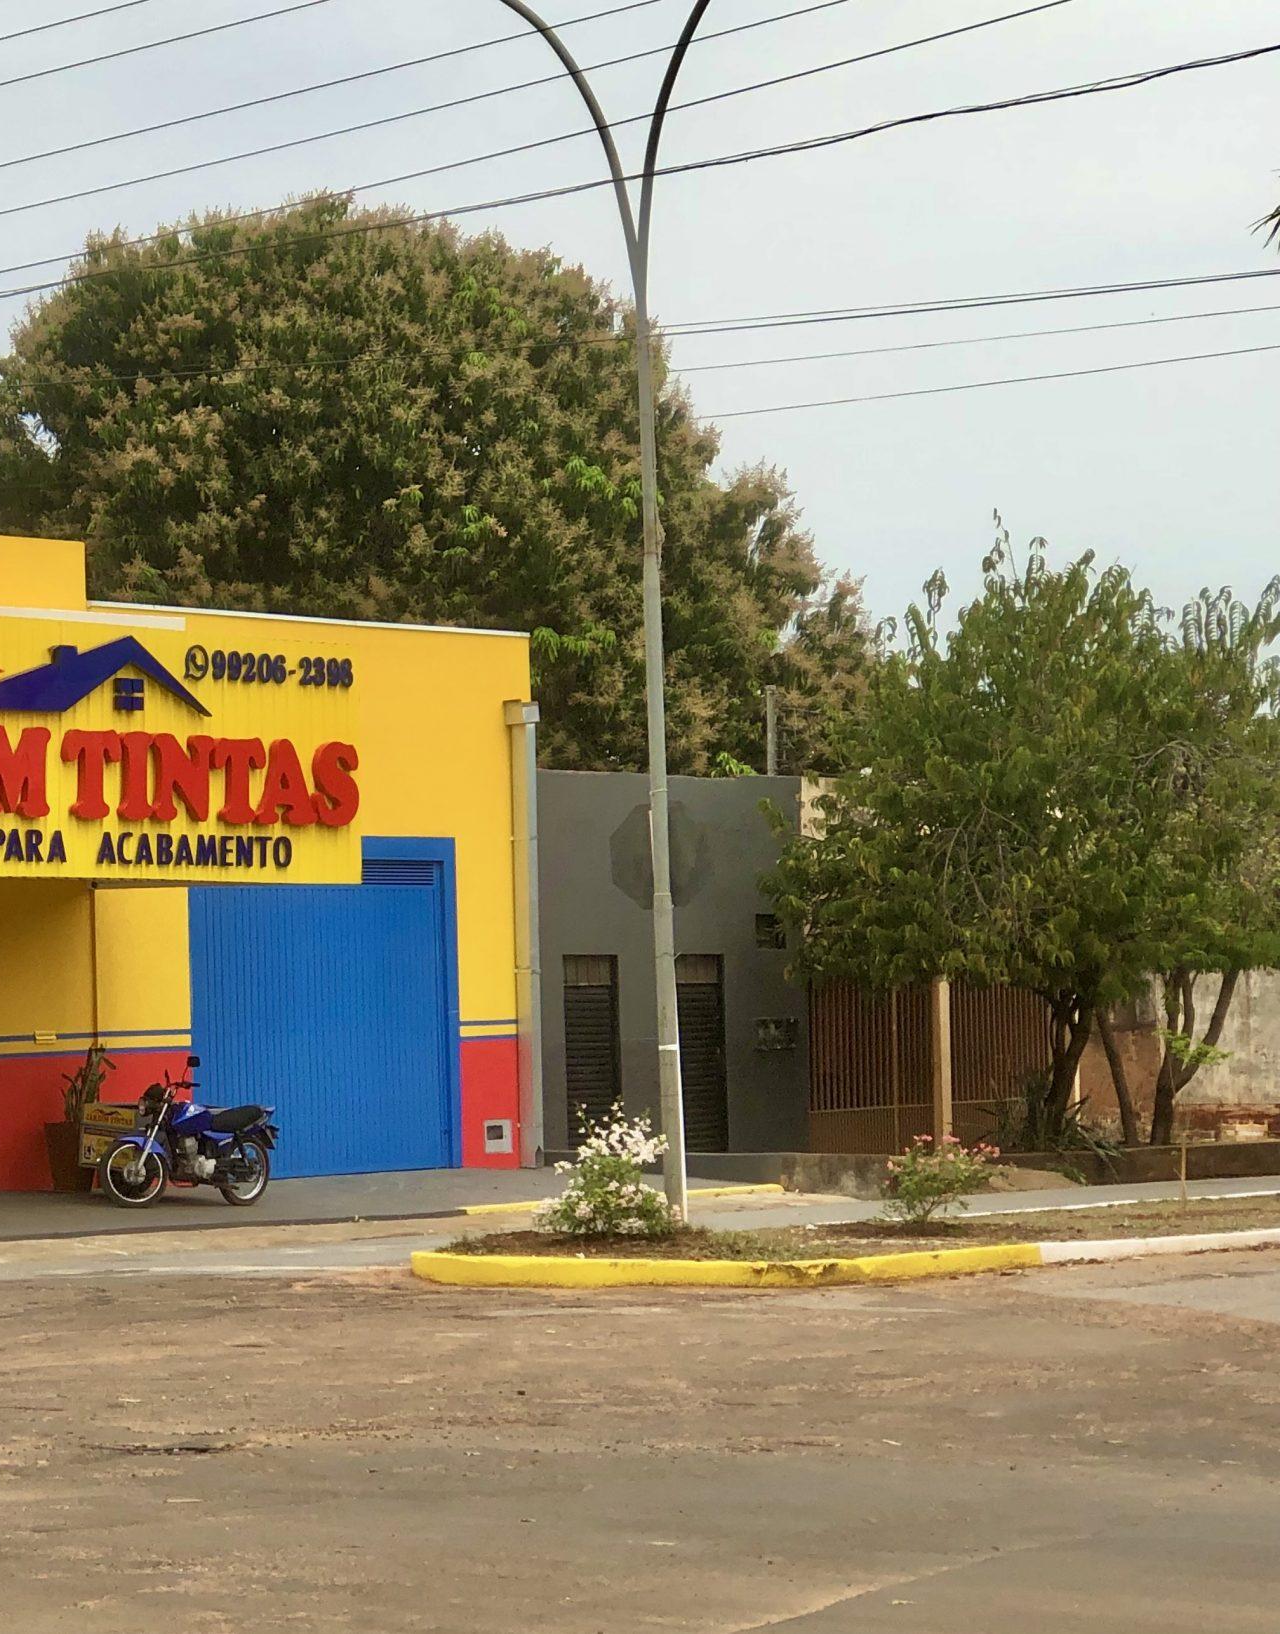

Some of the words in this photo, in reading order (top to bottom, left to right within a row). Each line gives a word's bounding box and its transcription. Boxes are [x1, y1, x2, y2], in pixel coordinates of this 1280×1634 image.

[211, 649, 354, 688] 99206-2398
[60, 729, 360, 827] TINTAS
[96, 832, 293, 869] ACABAMENTO
